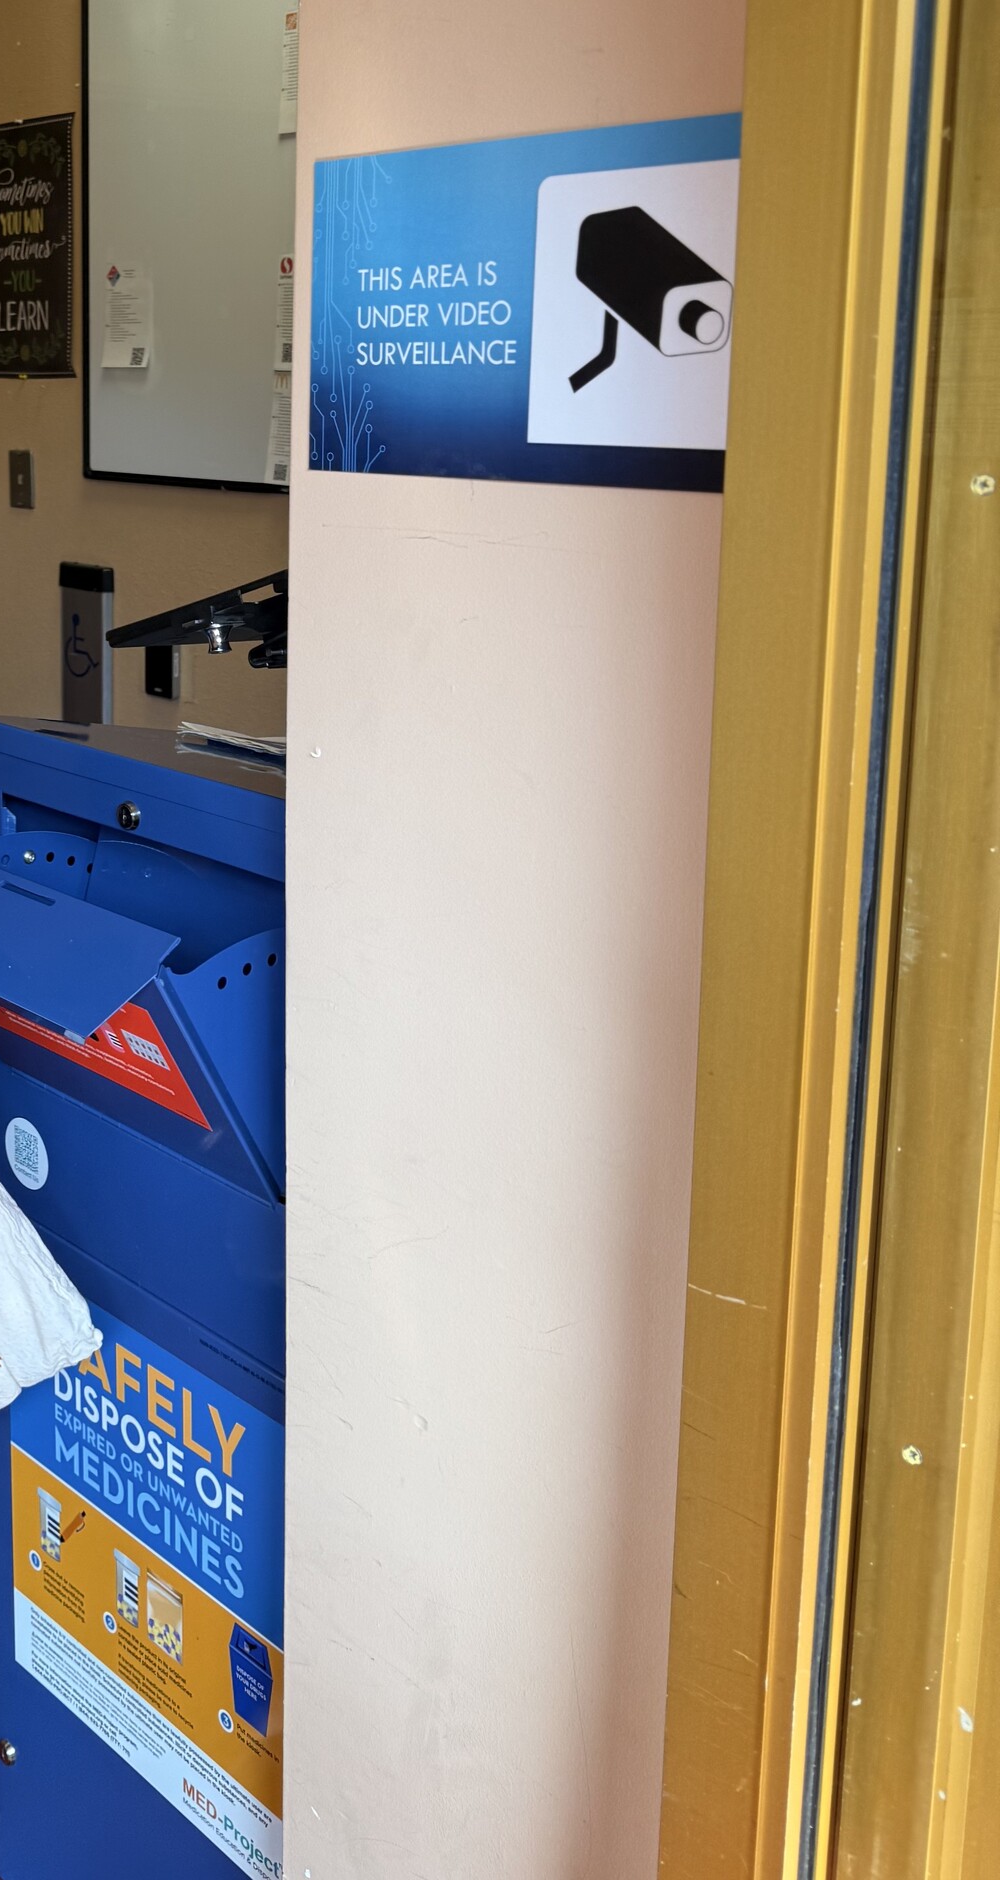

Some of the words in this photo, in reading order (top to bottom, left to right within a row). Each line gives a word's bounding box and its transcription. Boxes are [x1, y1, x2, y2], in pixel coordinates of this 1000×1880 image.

[0, 211, 22, 236] YOU
[24, 208, 44, 234] WIN
[358, 266, 402, 292] THIS
[410, 263, 468, 289] AREA
[478, 261, 497, 286] IS
[357, 304, 429, 329] UNDER
[437, 300, 511, 326] VIDEO
[356, 340, 517, 365] SURVEILLANCE
[79, 1343, 246, 1477] AFELY
[54, 1369, 185, 1487] DISPOSE
[195, 1467, 244, 1522] OF
[55, 1403, 116, 1460] EXPIRED
[121, 1453, 143, 1482] OR
[147, 1470, 243, 1553] UNWANTED
[55, 1425, 244, 1599] MEDICINES
[33, 1554, 36, 1565] 1
[107, 1615, 113, 1629] 2
[236, 1664, 256, 1686] DISPOSE
[257, 1681, 264, 1692] OF
[236, 1671, 248, 1687] YOUR
[249, 1682, 266, 1702] DRUGS
[244, 1685, 256, 1701] HERE
[223, 1714, 229, 1728] 3
[236, 1722, 245, 1735] Put
[246, 1730, 272, 1758] medicines
[274, 1754, 279, 1763] in
[236, 1731, 244, 1743] the
[246, 1739, 261, 1757] kiosk.
[183, 1796, 214, 1831] Medication
[216, 1827, 245, 1860] Education
[246, 1855, 251, 1865] &
